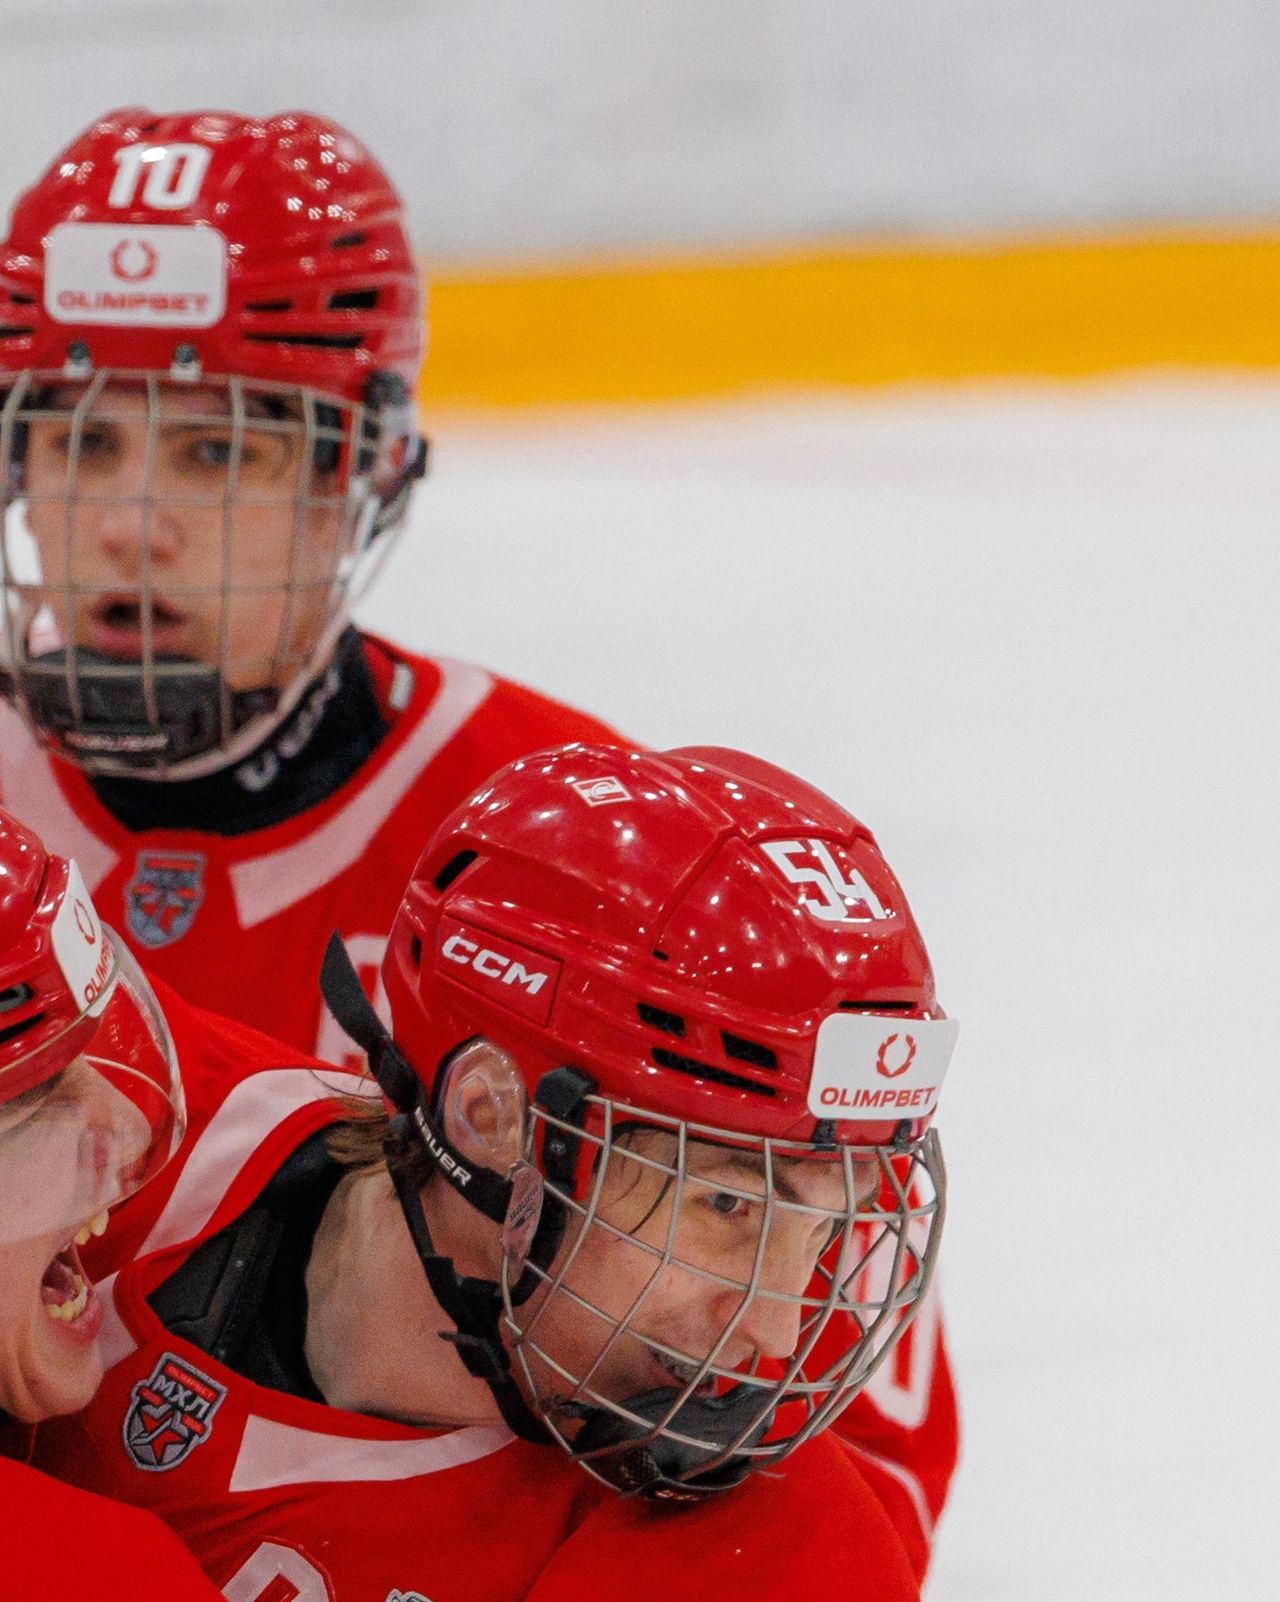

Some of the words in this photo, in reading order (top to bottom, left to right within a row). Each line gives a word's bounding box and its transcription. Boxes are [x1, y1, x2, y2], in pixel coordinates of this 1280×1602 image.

[107, 142, 213, 210] 10
[761, 838, 888, 923] 54
[441, 933, 548, 995] CCM
[820, 1086, 937, 1109] OLIMPBET
[151, 1373, 211, 1420] МХЛ
